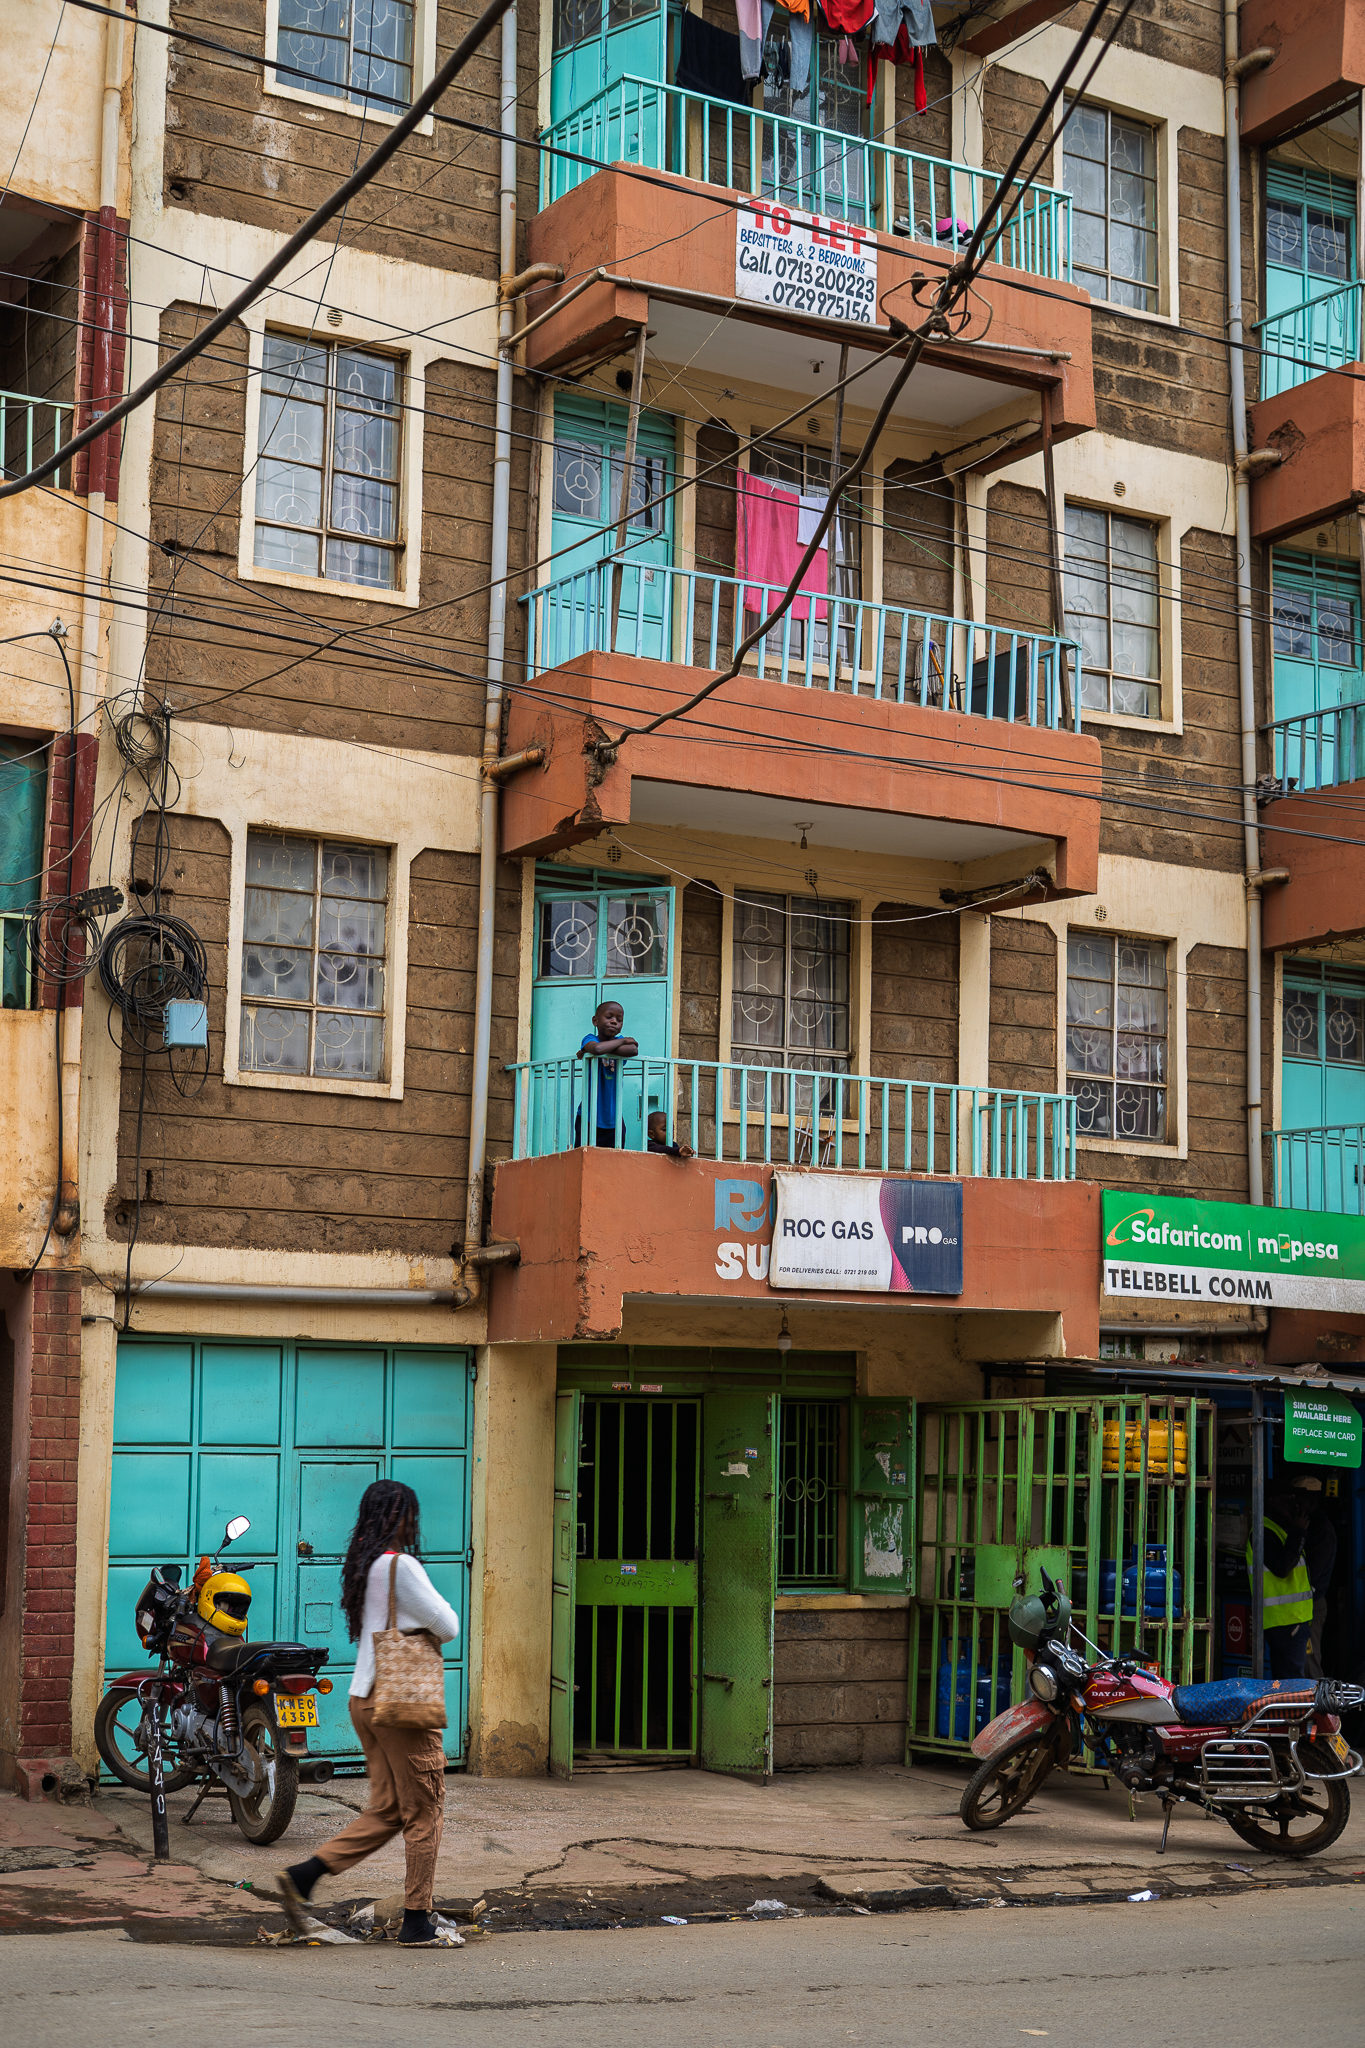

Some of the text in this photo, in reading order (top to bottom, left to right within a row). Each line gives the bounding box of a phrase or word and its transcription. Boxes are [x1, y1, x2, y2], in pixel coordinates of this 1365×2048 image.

[750, 200, 867, 255] TO LET
[740, 228, 866, 274] BEDSITTERS & 2 BEDROOMS
[739, 246, 773, 275] Call.
[783, 1218, 874, 1241] ROC GAS
[902, 1226, 958, 1246] PRO GAS
[1131, 1219, 1242, 1252] Safaricom
[791, 1267, 824, 1275] DELIVERIES
[1107, 1268, 1273, 1300] TELEBELL COMM
[1292, 1401, 1328, 1412] SIM CARD
[1292, 1410, 1352, 1424] AVAILABLE HERE
[1292, 1427, 1356, 1441] REPLACE SIM CARD
[1218, 1446, 1245, 1458] EQUITY
[1303, 1447, 1328, 1455] Safaricom
[1218, 1473, 1246, 1486] AGENT
[279, 1698, 313, 1710] KMEC
[281, 1711, 315, 1723] 435P
